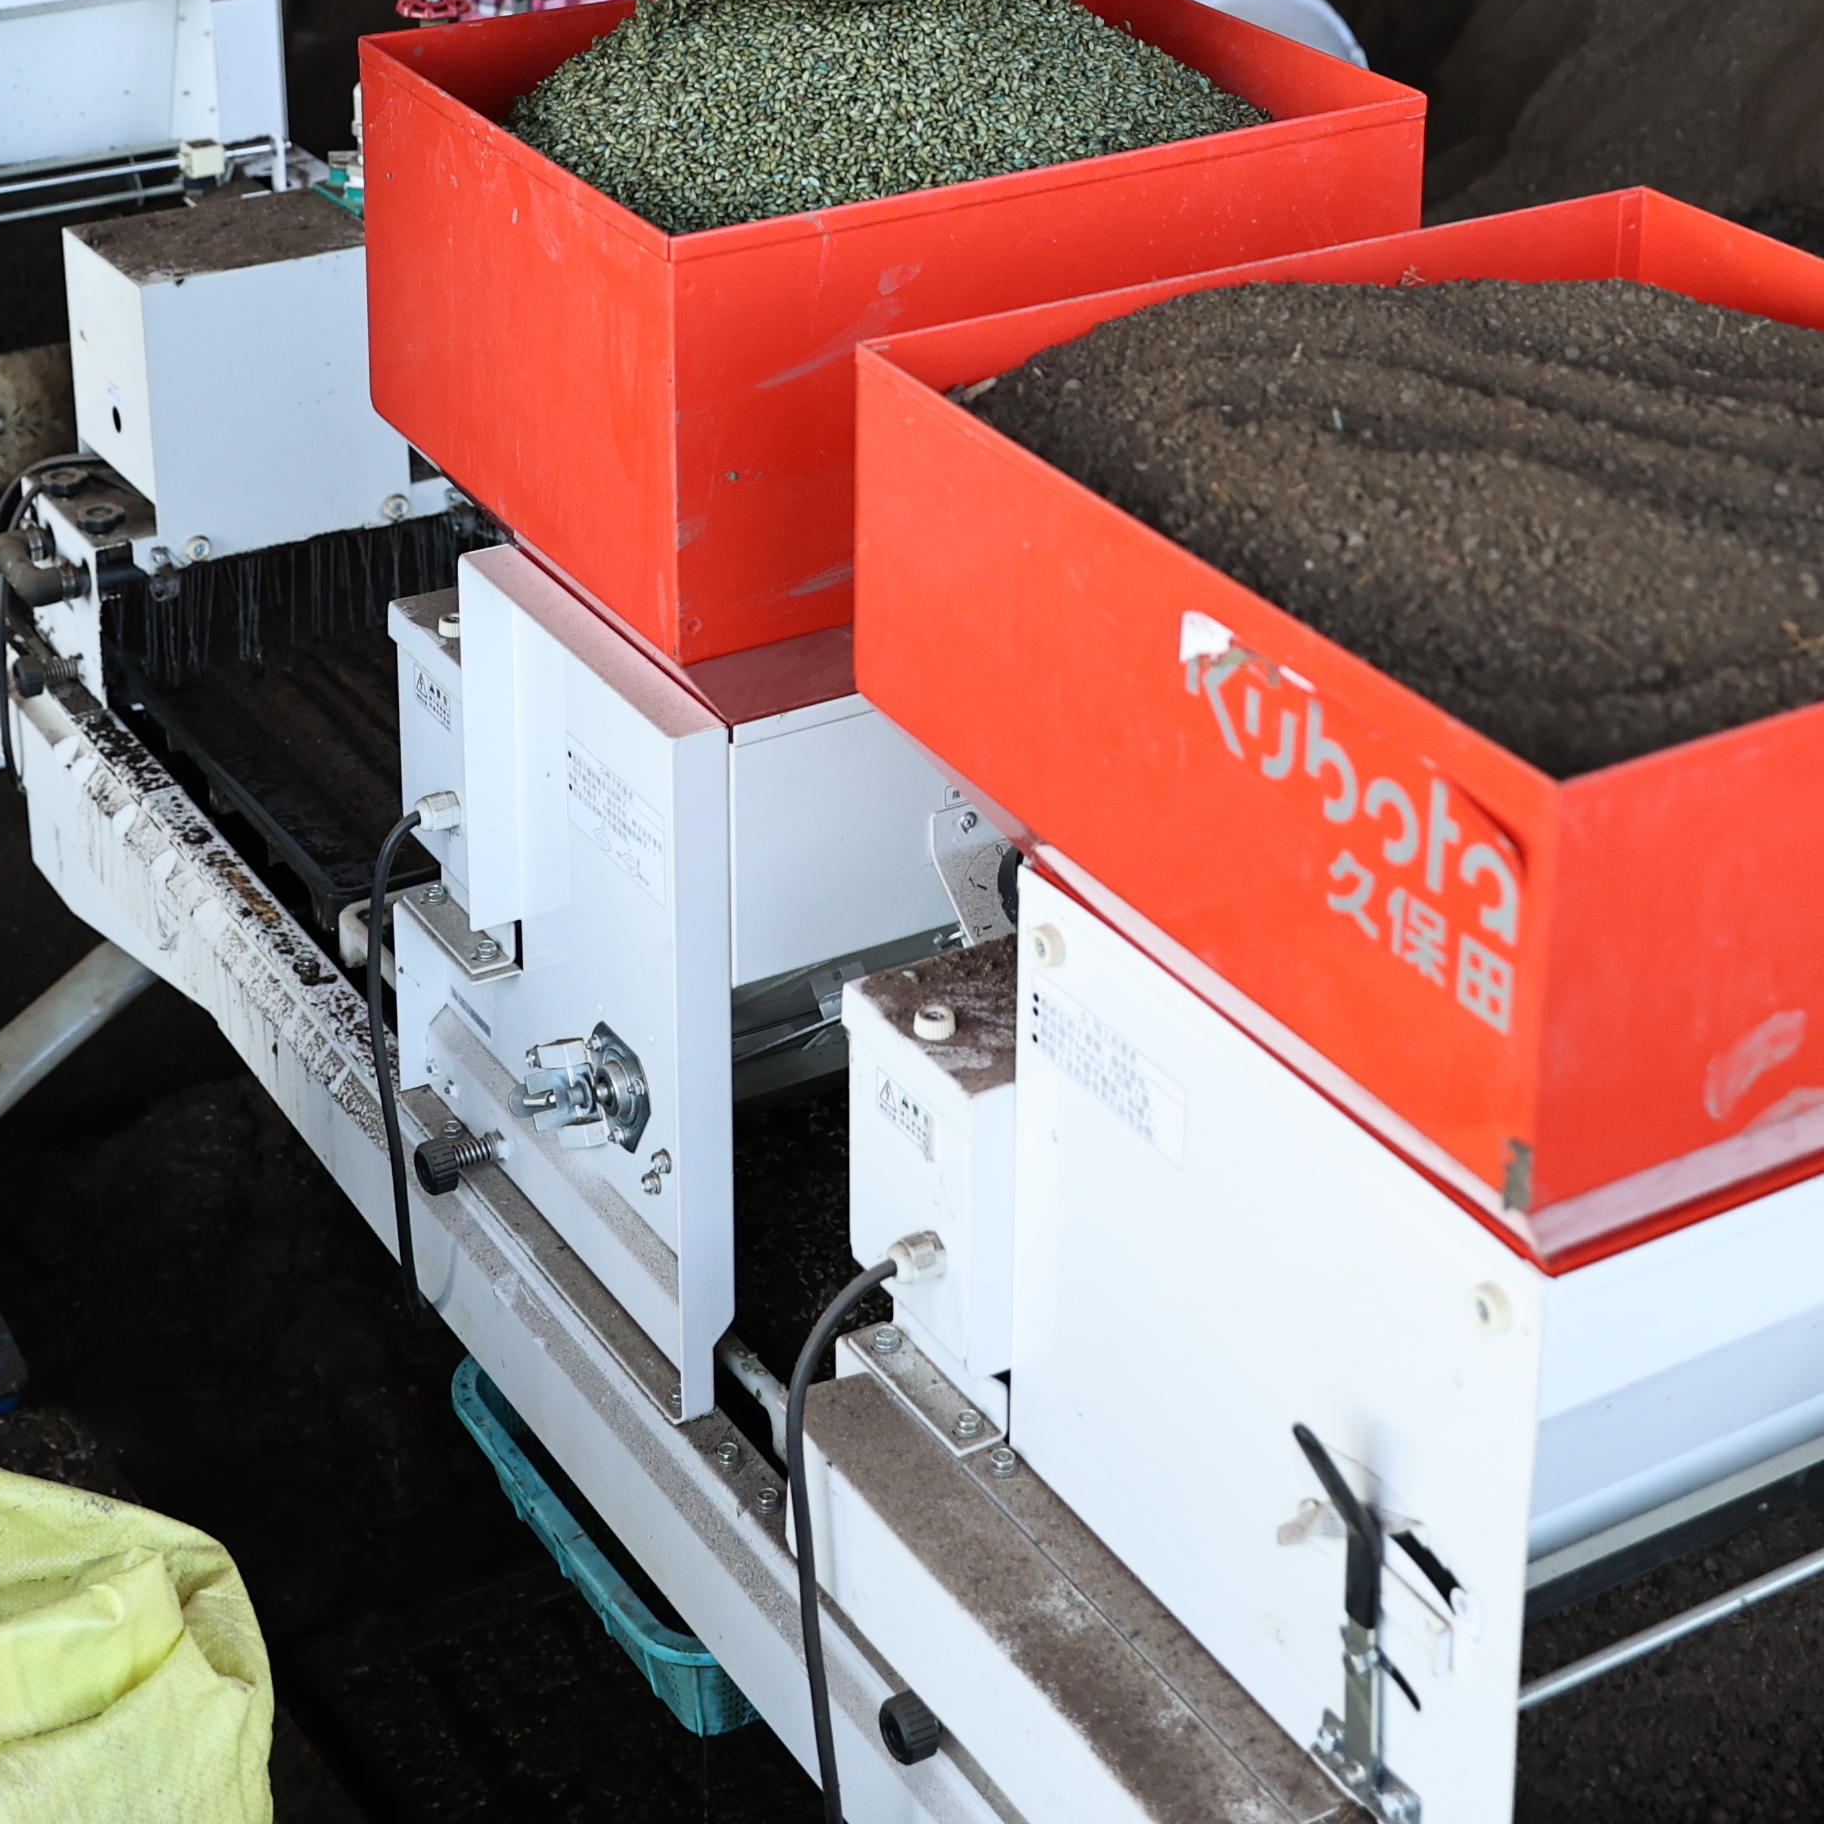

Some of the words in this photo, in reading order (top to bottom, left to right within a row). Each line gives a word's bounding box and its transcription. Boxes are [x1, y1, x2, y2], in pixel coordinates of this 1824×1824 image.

[968, 876, 976, 889] 1
[973, 925, 983, 938] 2
[1326, 849, 1515, 1035] 久保田
